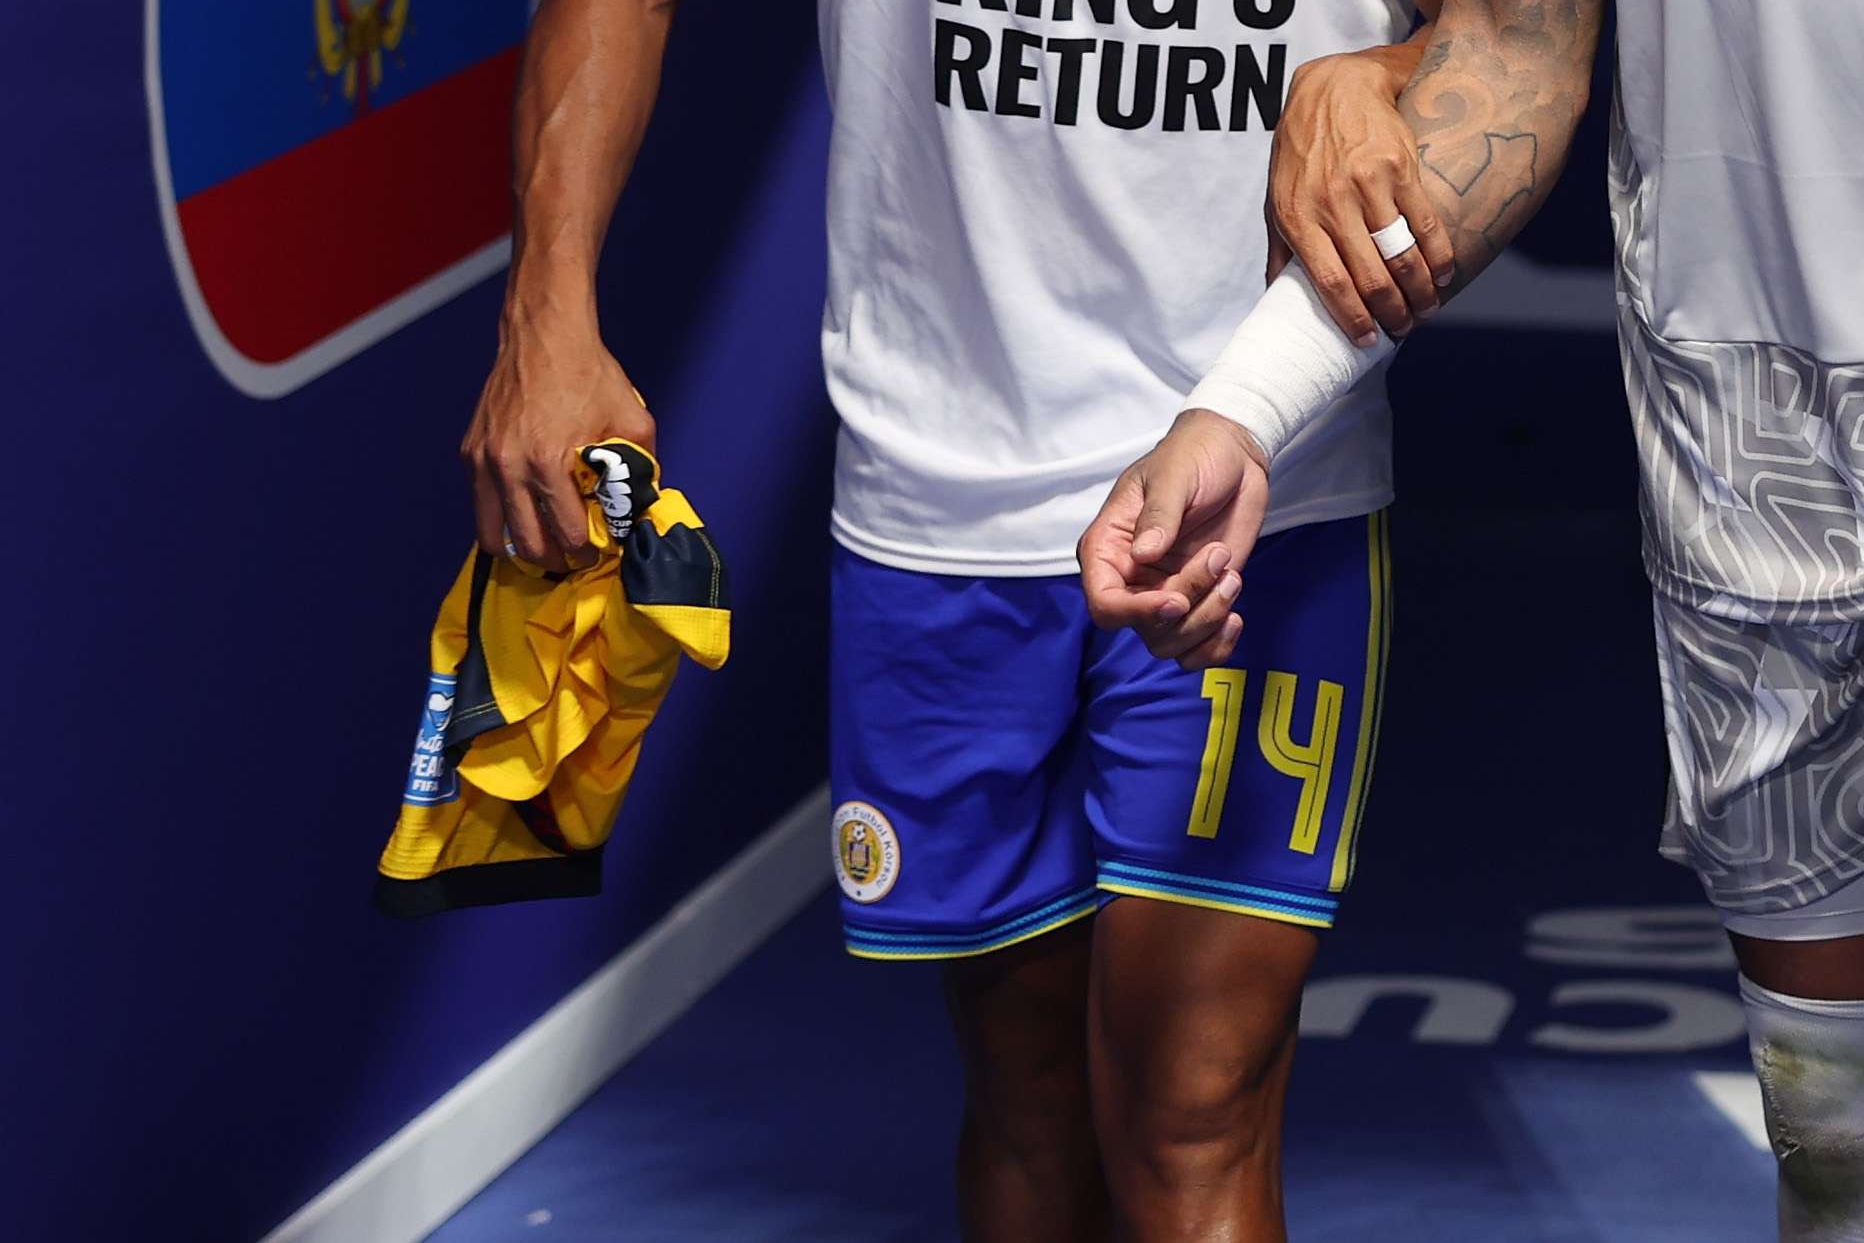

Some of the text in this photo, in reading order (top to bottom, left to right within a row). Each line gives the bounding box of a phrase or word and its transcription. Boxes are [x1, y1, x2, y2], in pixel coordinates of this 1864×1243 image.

[934, 17, 1288, 133] RETURN
[1187, 667, 1344, 855] 14
[1298, 974, 1748, 1053] CU
